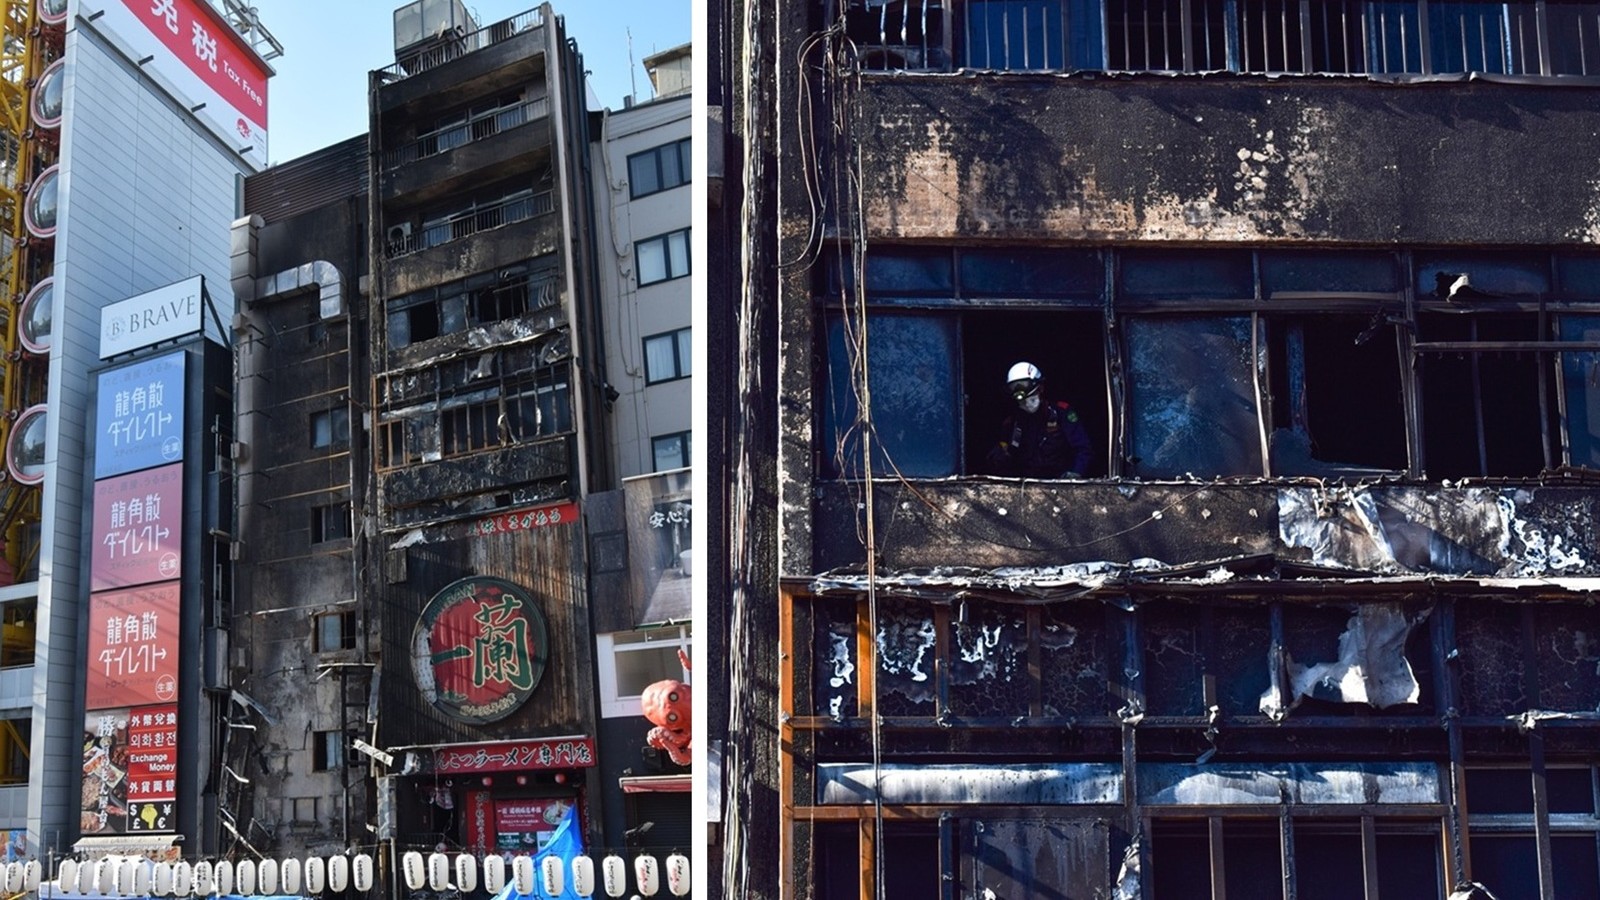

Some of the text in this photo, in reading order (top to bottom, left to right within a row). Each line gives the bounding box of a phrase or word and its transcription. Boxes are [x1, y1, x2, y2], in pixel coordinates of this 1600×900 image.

[223, 60, 263, 107] Tax Free
[129, 294, 197, 333] BRAVE
[115, 380, 164, 418] 龍角散
[107, 410, 173, 447] ダイレクト
[111, 492, 161, 529] 龍角散
[103, 524, 170, 560] ダイレクト
[107, 610, 158, 645] 龍角散
[430, 594, 534, 691] 一蘭
[98, 643, 168, 677] ダイレクト
[131, 730, 176, 748] 외화환전
[130, 753, 168, 763] Exchange
[149, 763, 176, 772] Money
